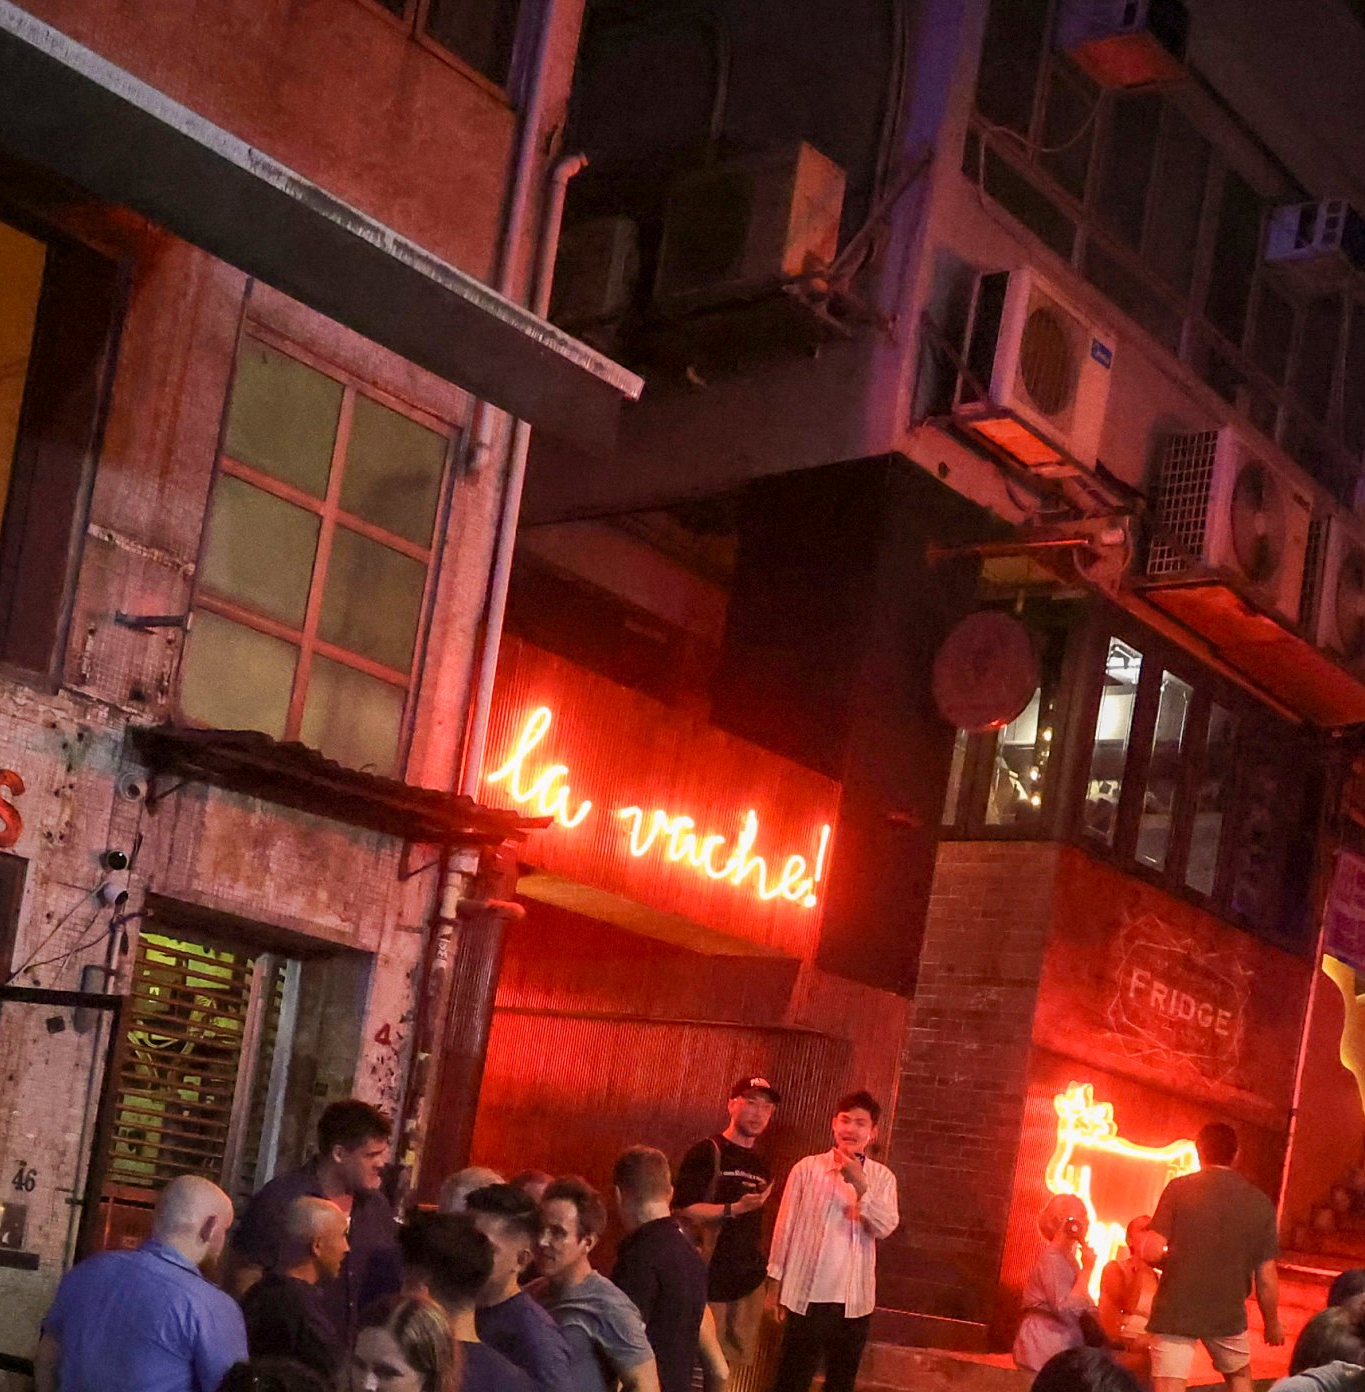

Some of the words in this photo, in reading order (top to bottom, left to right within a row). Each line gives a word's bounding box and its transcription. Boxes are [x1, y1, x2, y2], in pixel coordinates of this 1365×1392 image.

[487, 706, 592, 829] la
[1128, 967, 1233, 1037] FRIDGE
[11, 1168, 38, 1193] 46
